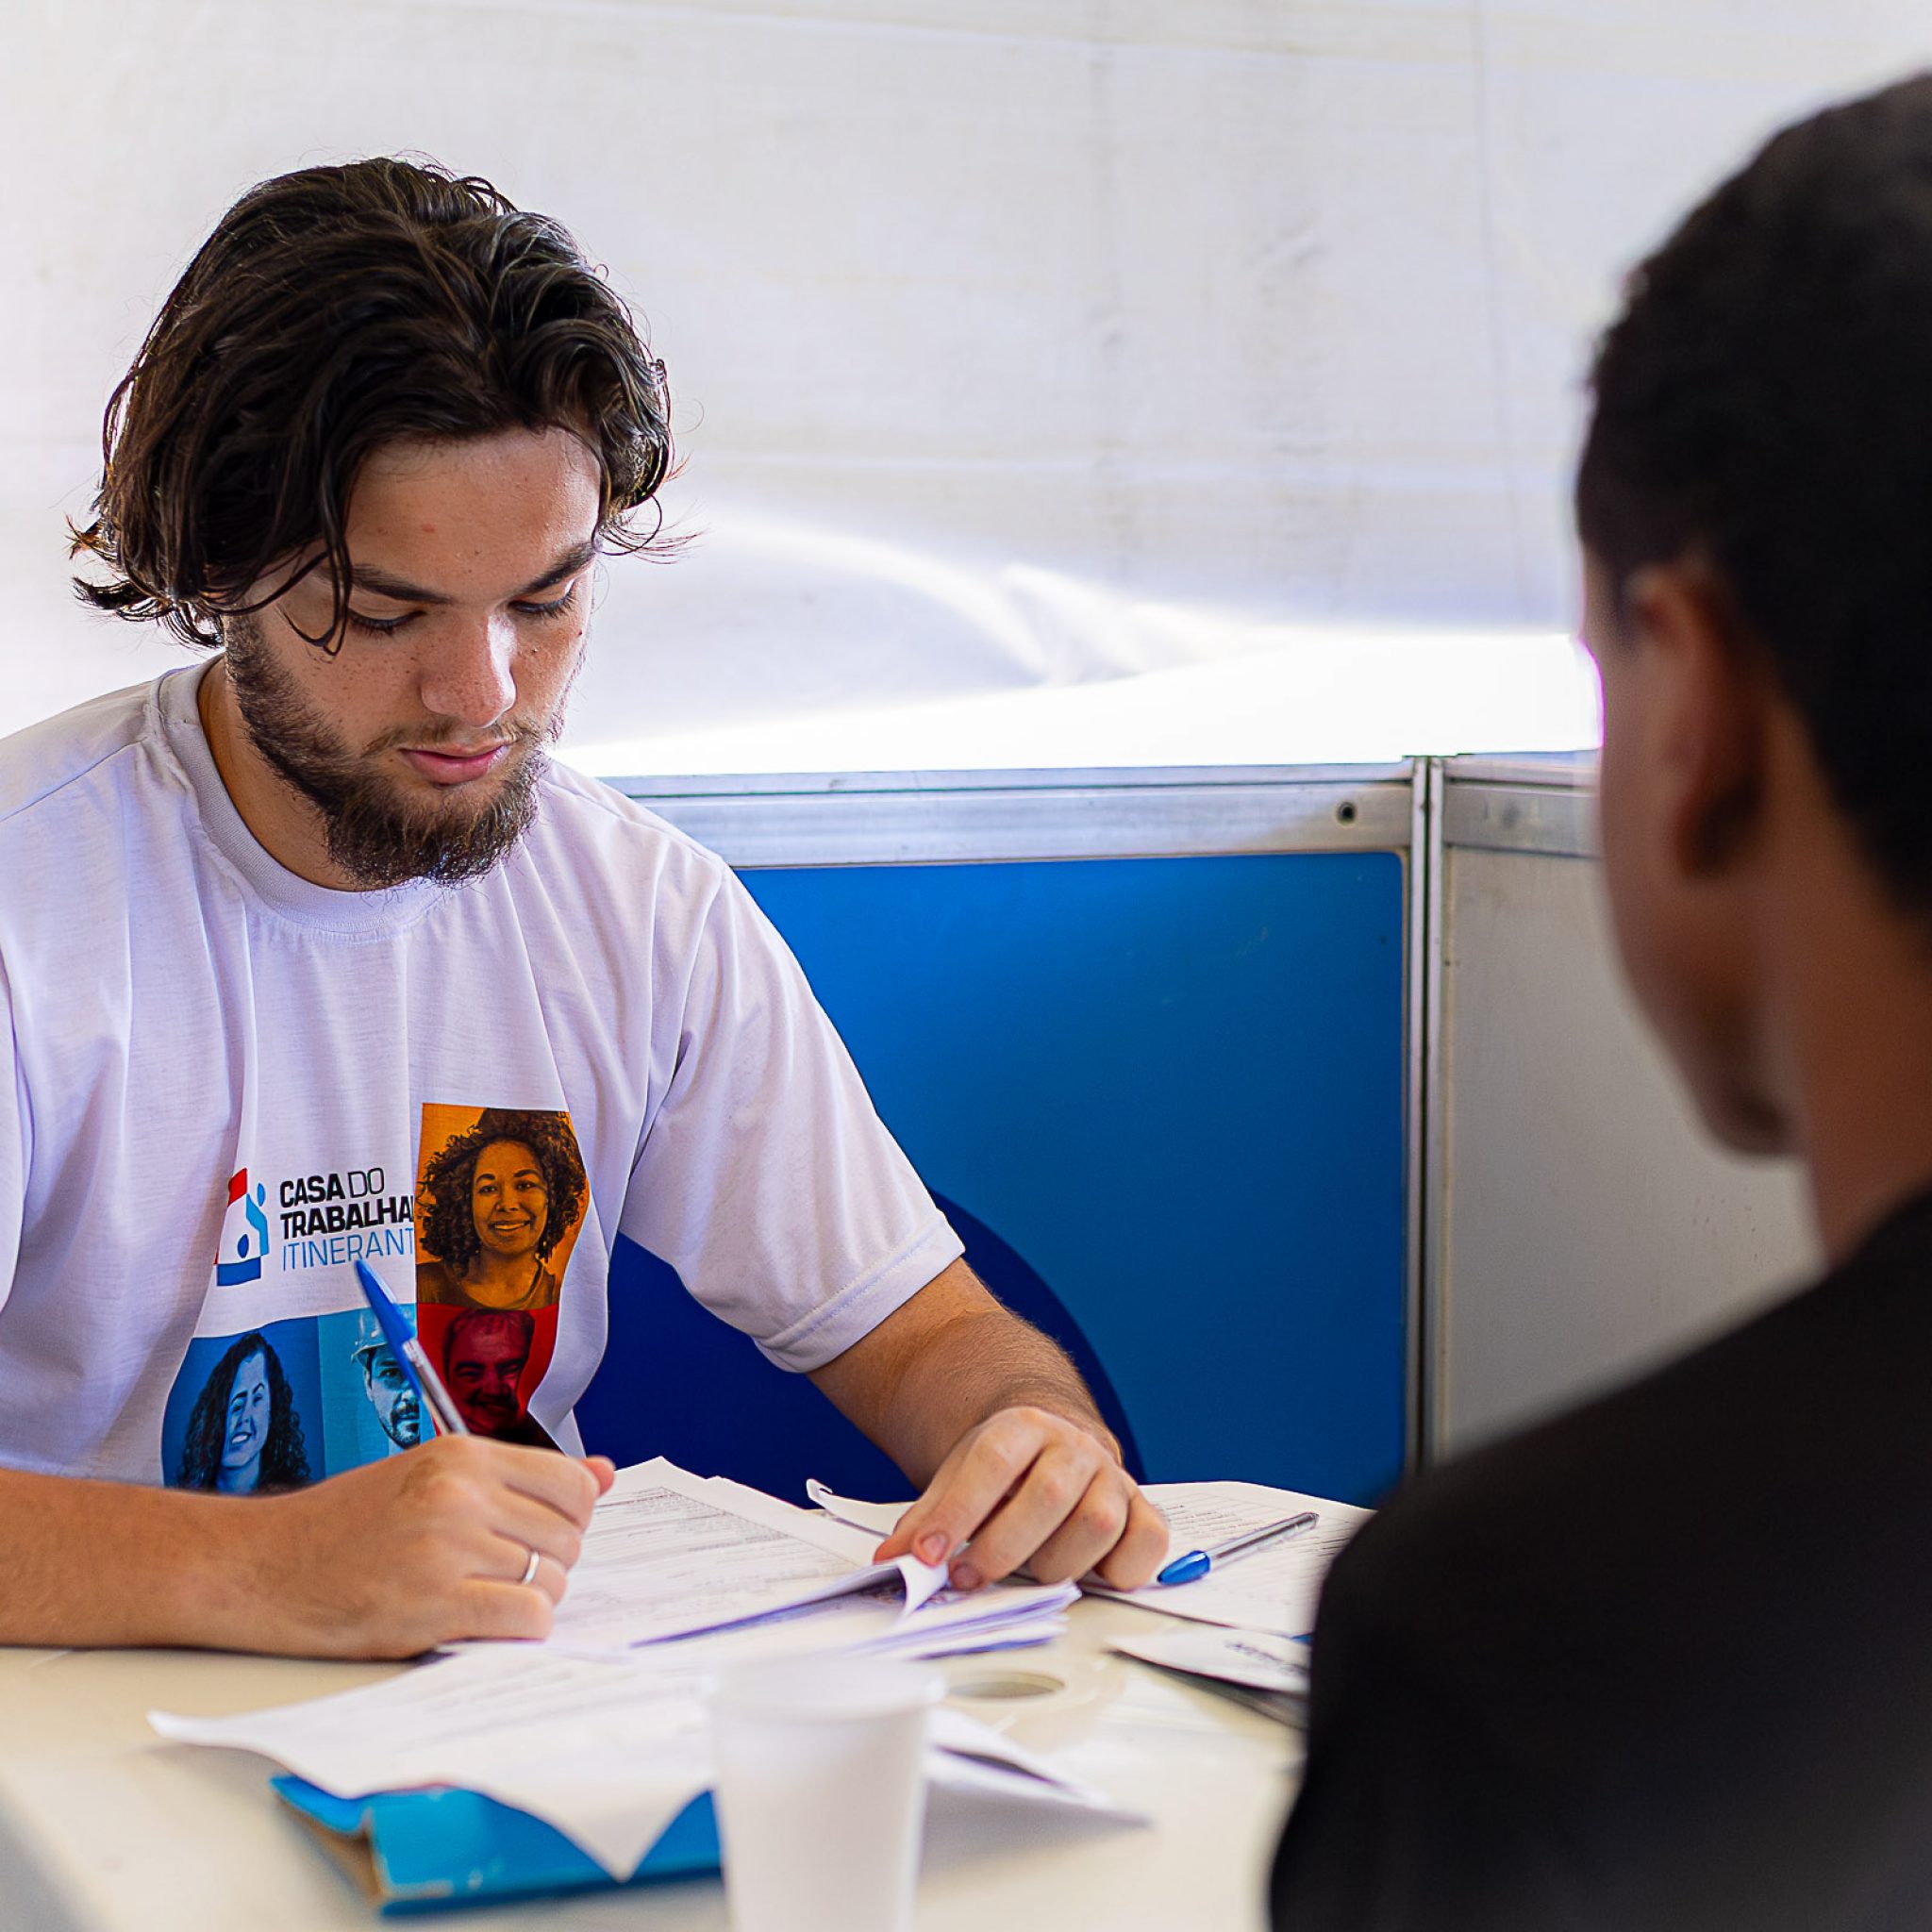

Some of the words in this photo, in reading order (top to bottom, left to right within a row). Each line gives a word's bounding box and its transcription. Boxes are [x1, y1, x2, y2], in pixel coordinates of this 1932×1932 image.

[280, 1173, 345, 1208] CASA
[347, 1168, 385, 1197] DO
[280, 1195, 414, 1240] TRABALHA
